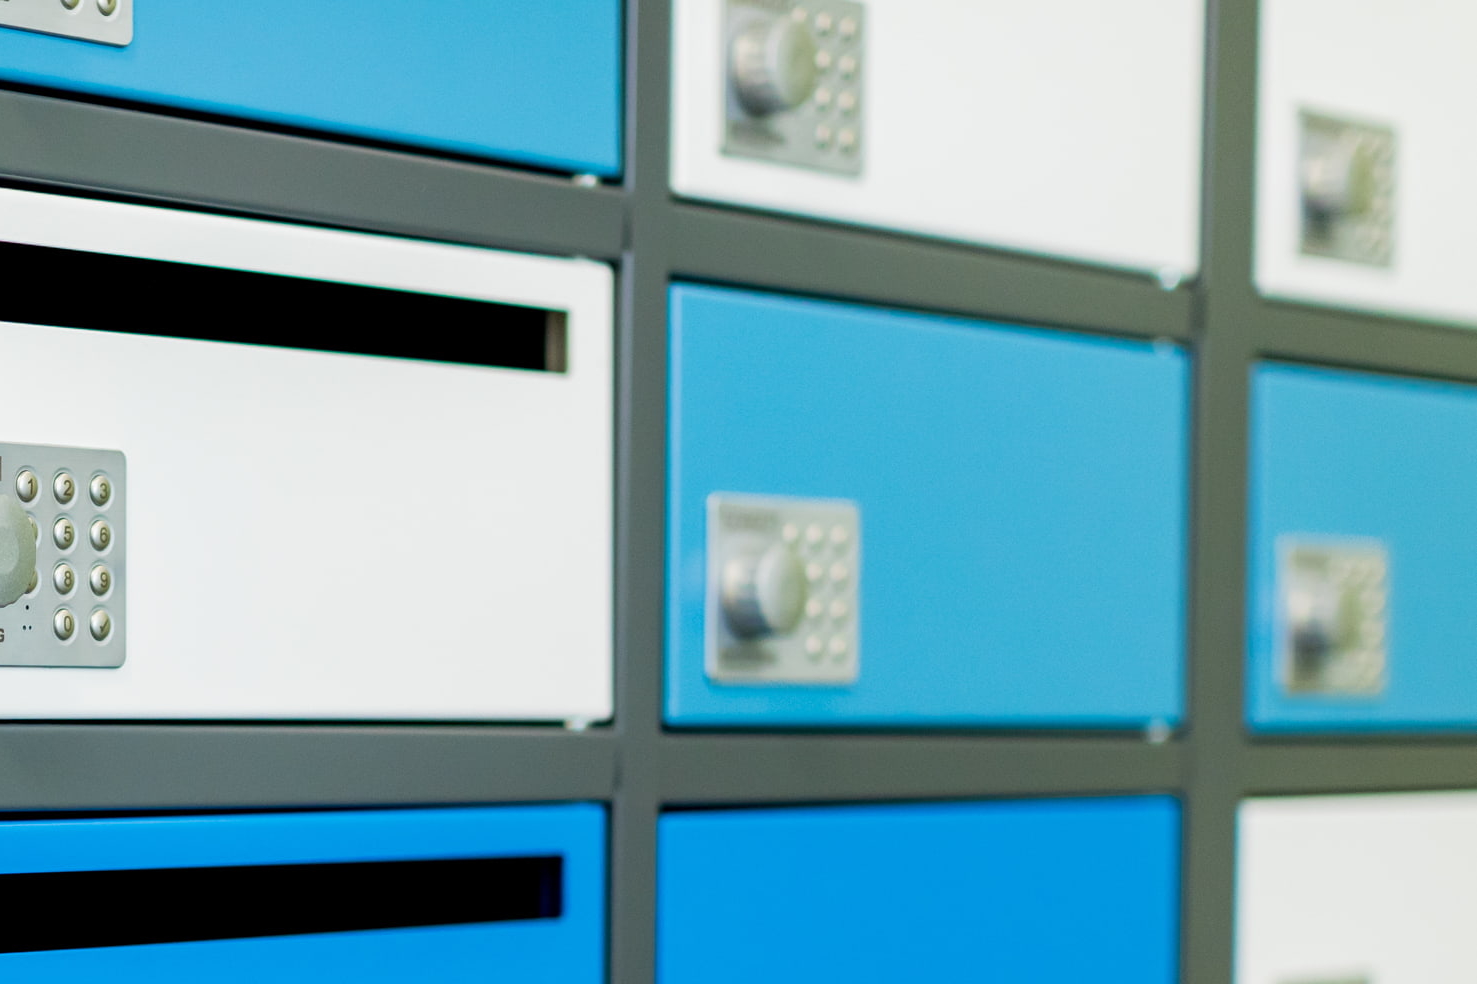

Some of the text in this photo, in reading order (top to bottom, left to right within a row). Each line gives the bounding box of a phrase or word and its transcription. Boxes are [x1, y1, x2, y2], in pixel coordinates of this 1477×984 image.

[27, 478, 107, 499] 1 2 3
[63, 526, 107, 543] 5 6
[63, 570, 107, 588] 8 9
[63, 615, 71, 632] 0
